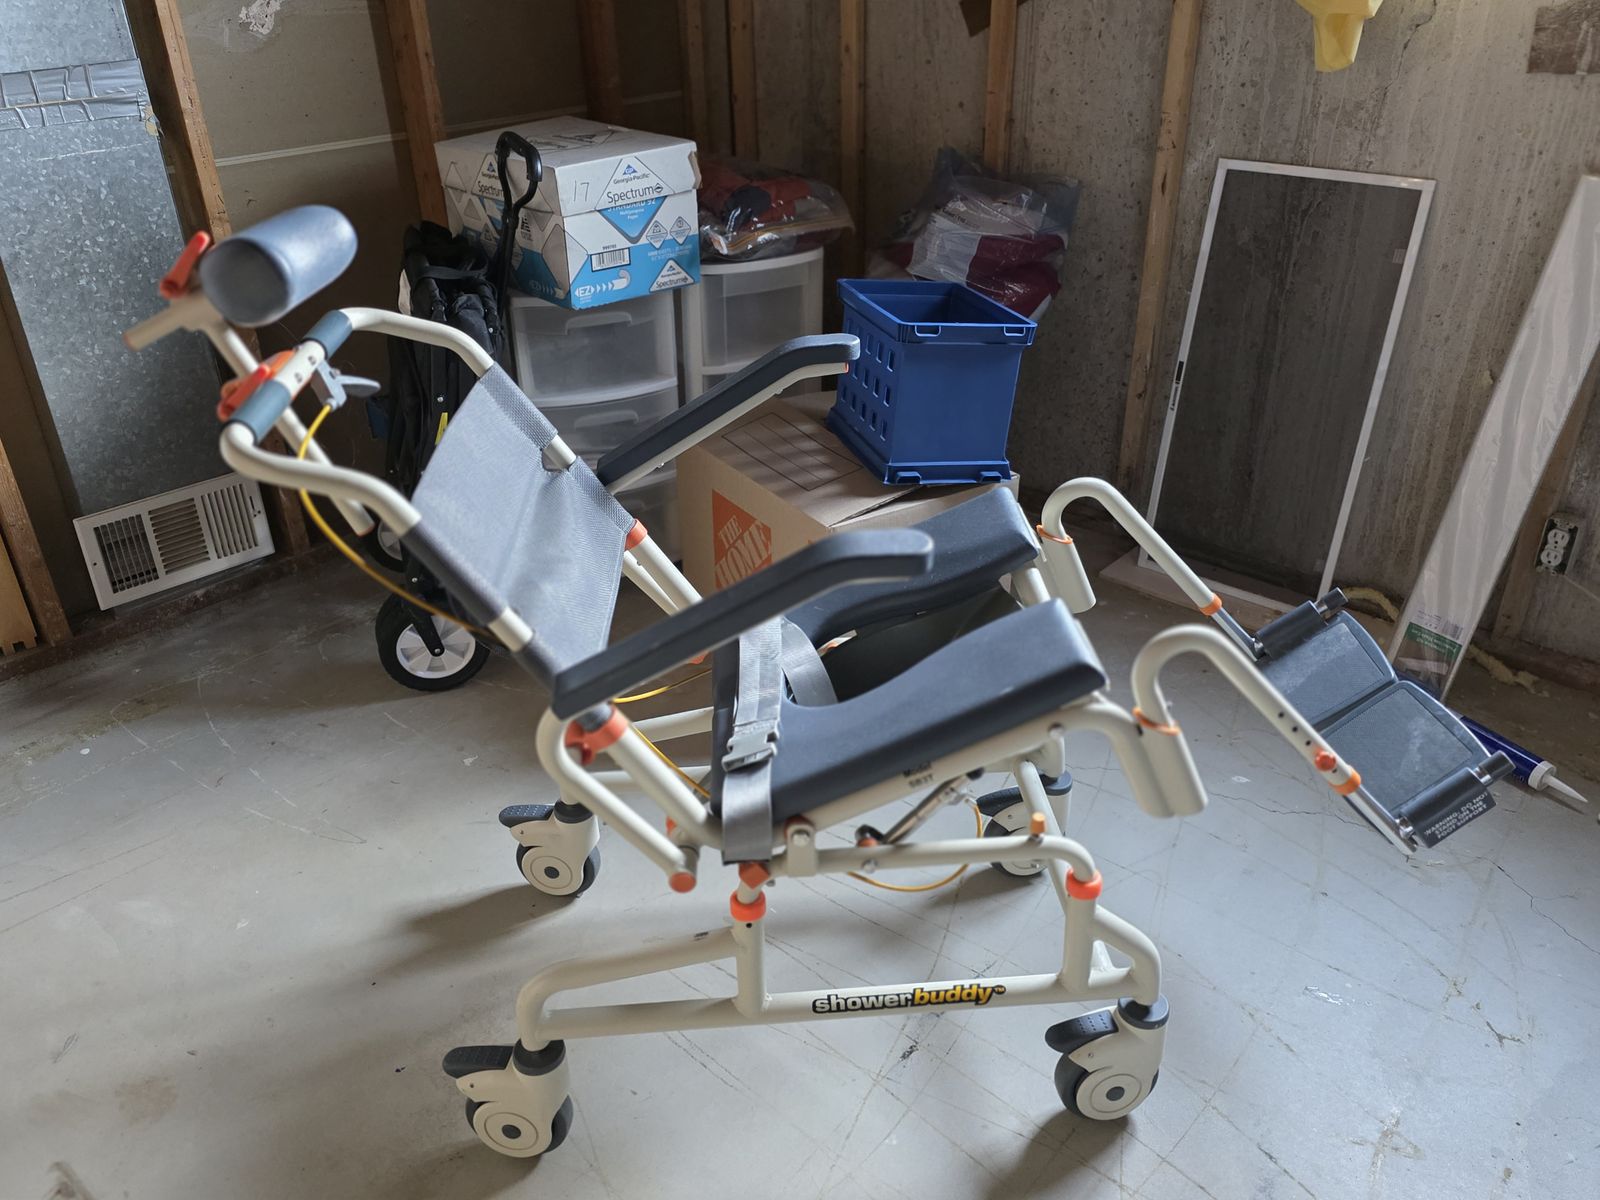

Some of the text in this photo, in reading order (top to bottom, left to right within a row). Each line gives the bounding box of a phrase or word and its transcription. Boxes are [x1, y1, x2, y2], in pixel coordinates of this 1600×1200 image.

[573, 179, 590, 202] 17
[606, 185, 655, 205] Spectrum
[580, 286, 592, 296] EZ
[656, 278, 683, 289] Spectrum
[719, 514, 742, 549] THE
[715, 522, 772, 590] HOME
[1435, 801, 1484, 835] STAND ON THE
[1460, 802, 1473, 812] DO
[1437, 804, 1488, 839] FOOT SUPPORT
